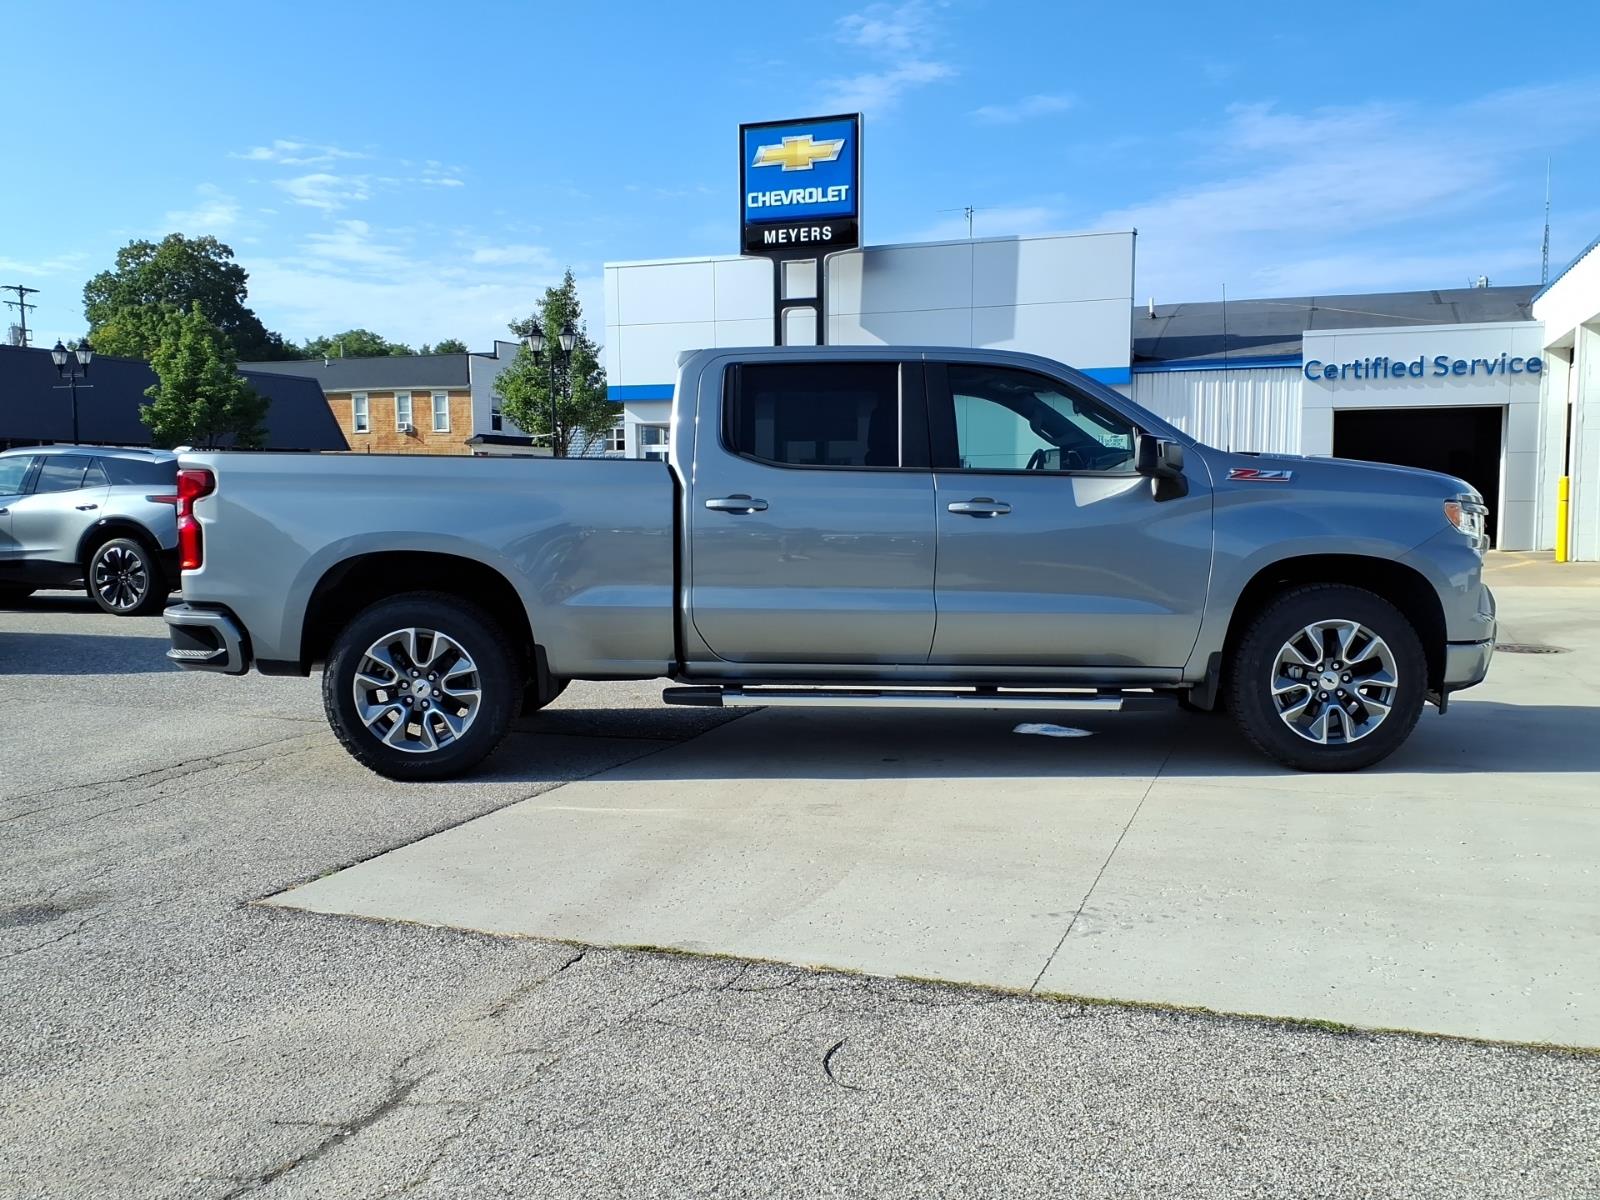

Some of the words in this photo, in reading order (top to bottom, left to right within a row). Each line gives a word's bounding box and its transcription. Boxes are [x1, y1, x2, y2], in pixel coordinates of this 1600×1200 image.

[747, 185, 849, 208] CHEVROLET
[764, 226, 832, 244] MEYERS
[1304, 355, 1425, 381] Certified
[1432, 352, 1543, 377] Service
[1226, 468, 1293, 482] Z71
